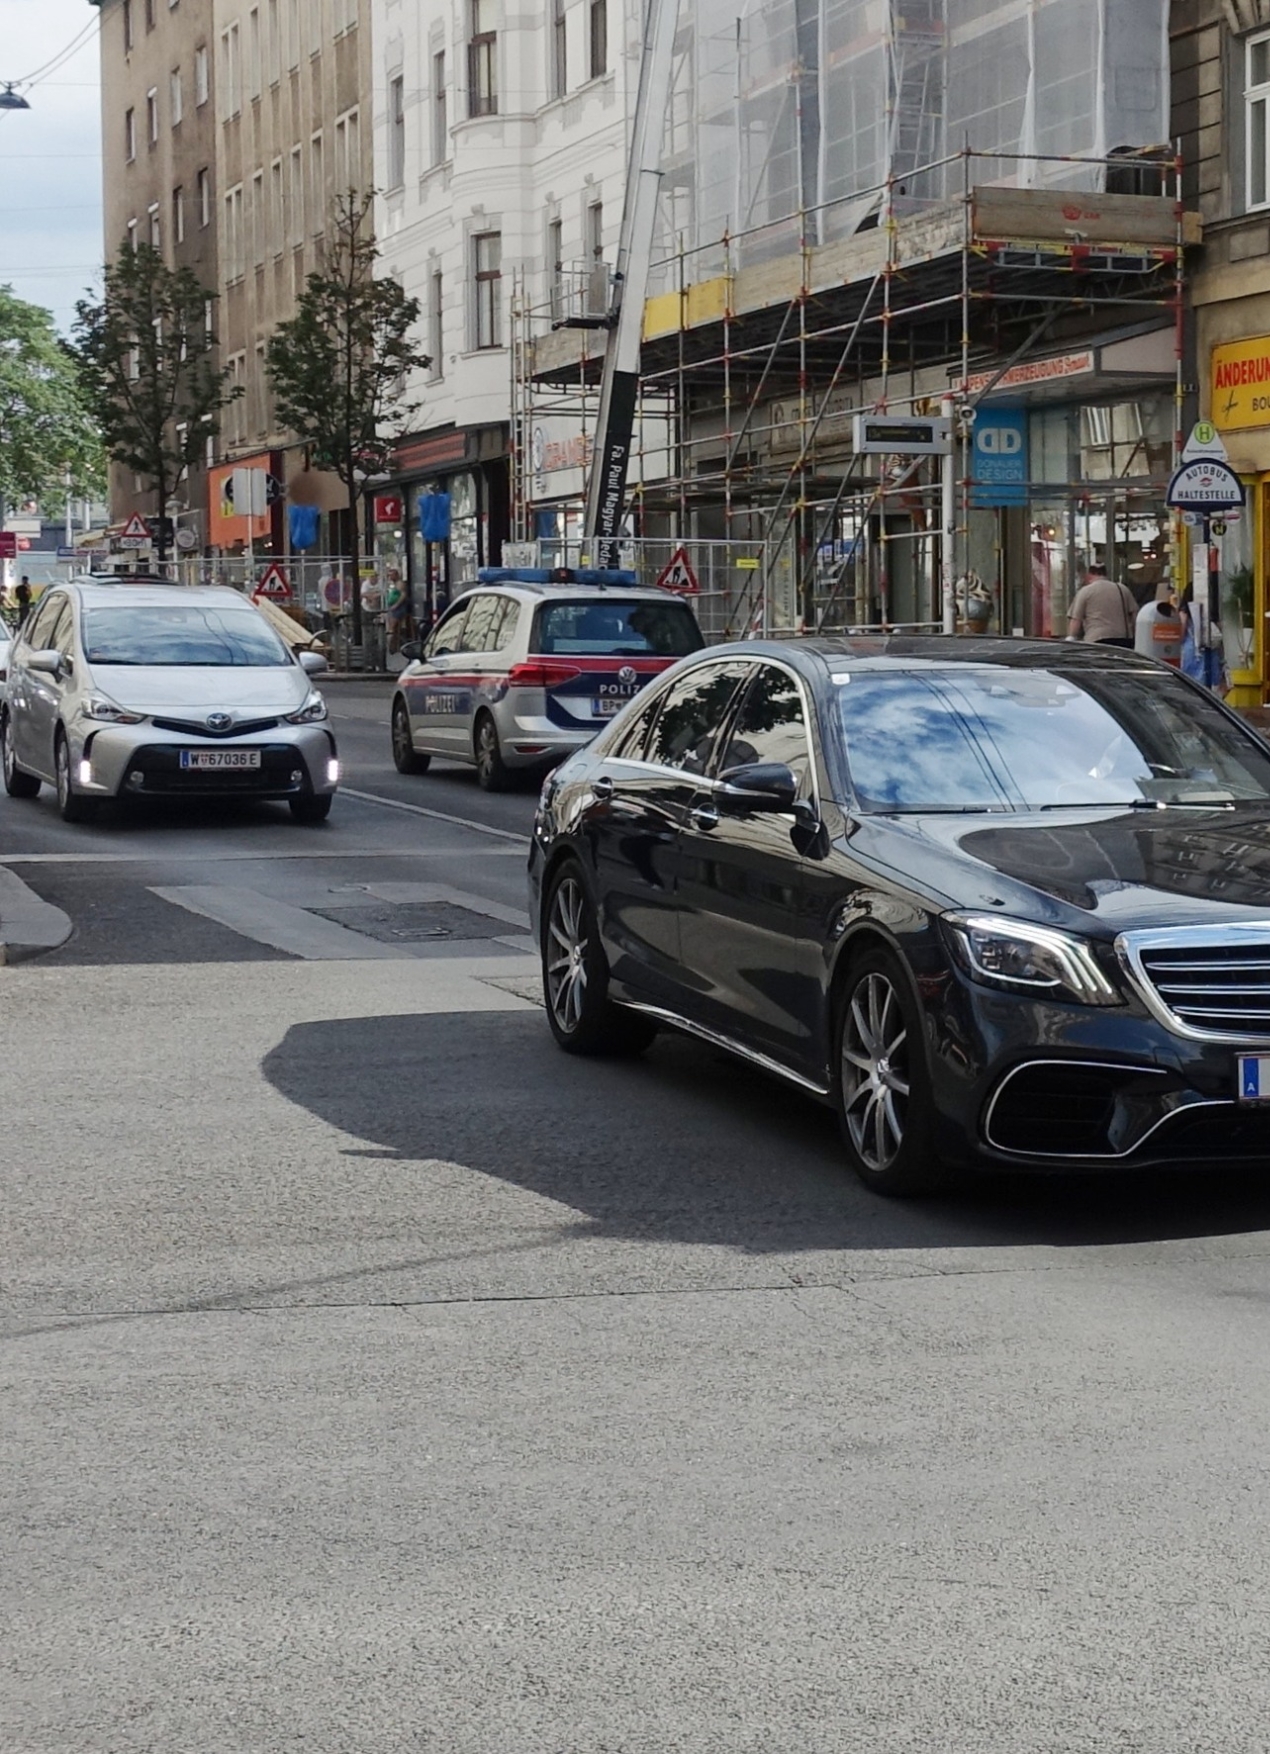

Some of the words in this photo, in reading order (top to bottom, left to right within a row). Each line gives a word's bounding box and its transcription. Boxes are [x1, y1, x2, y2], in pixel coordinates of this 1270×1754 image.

[1200, 426, 1210, 440] H
[610, 445, 625, 462] Fa.
[608, 464, 622, 494] Paul
[977, 469, 1023, 480] DESIGN
[1186, 465, 1229, 482] AUTOBUS
[1178, 490, 1235, 499] HALTESTELLE
[599, 684, 643, 695] POLIZ
